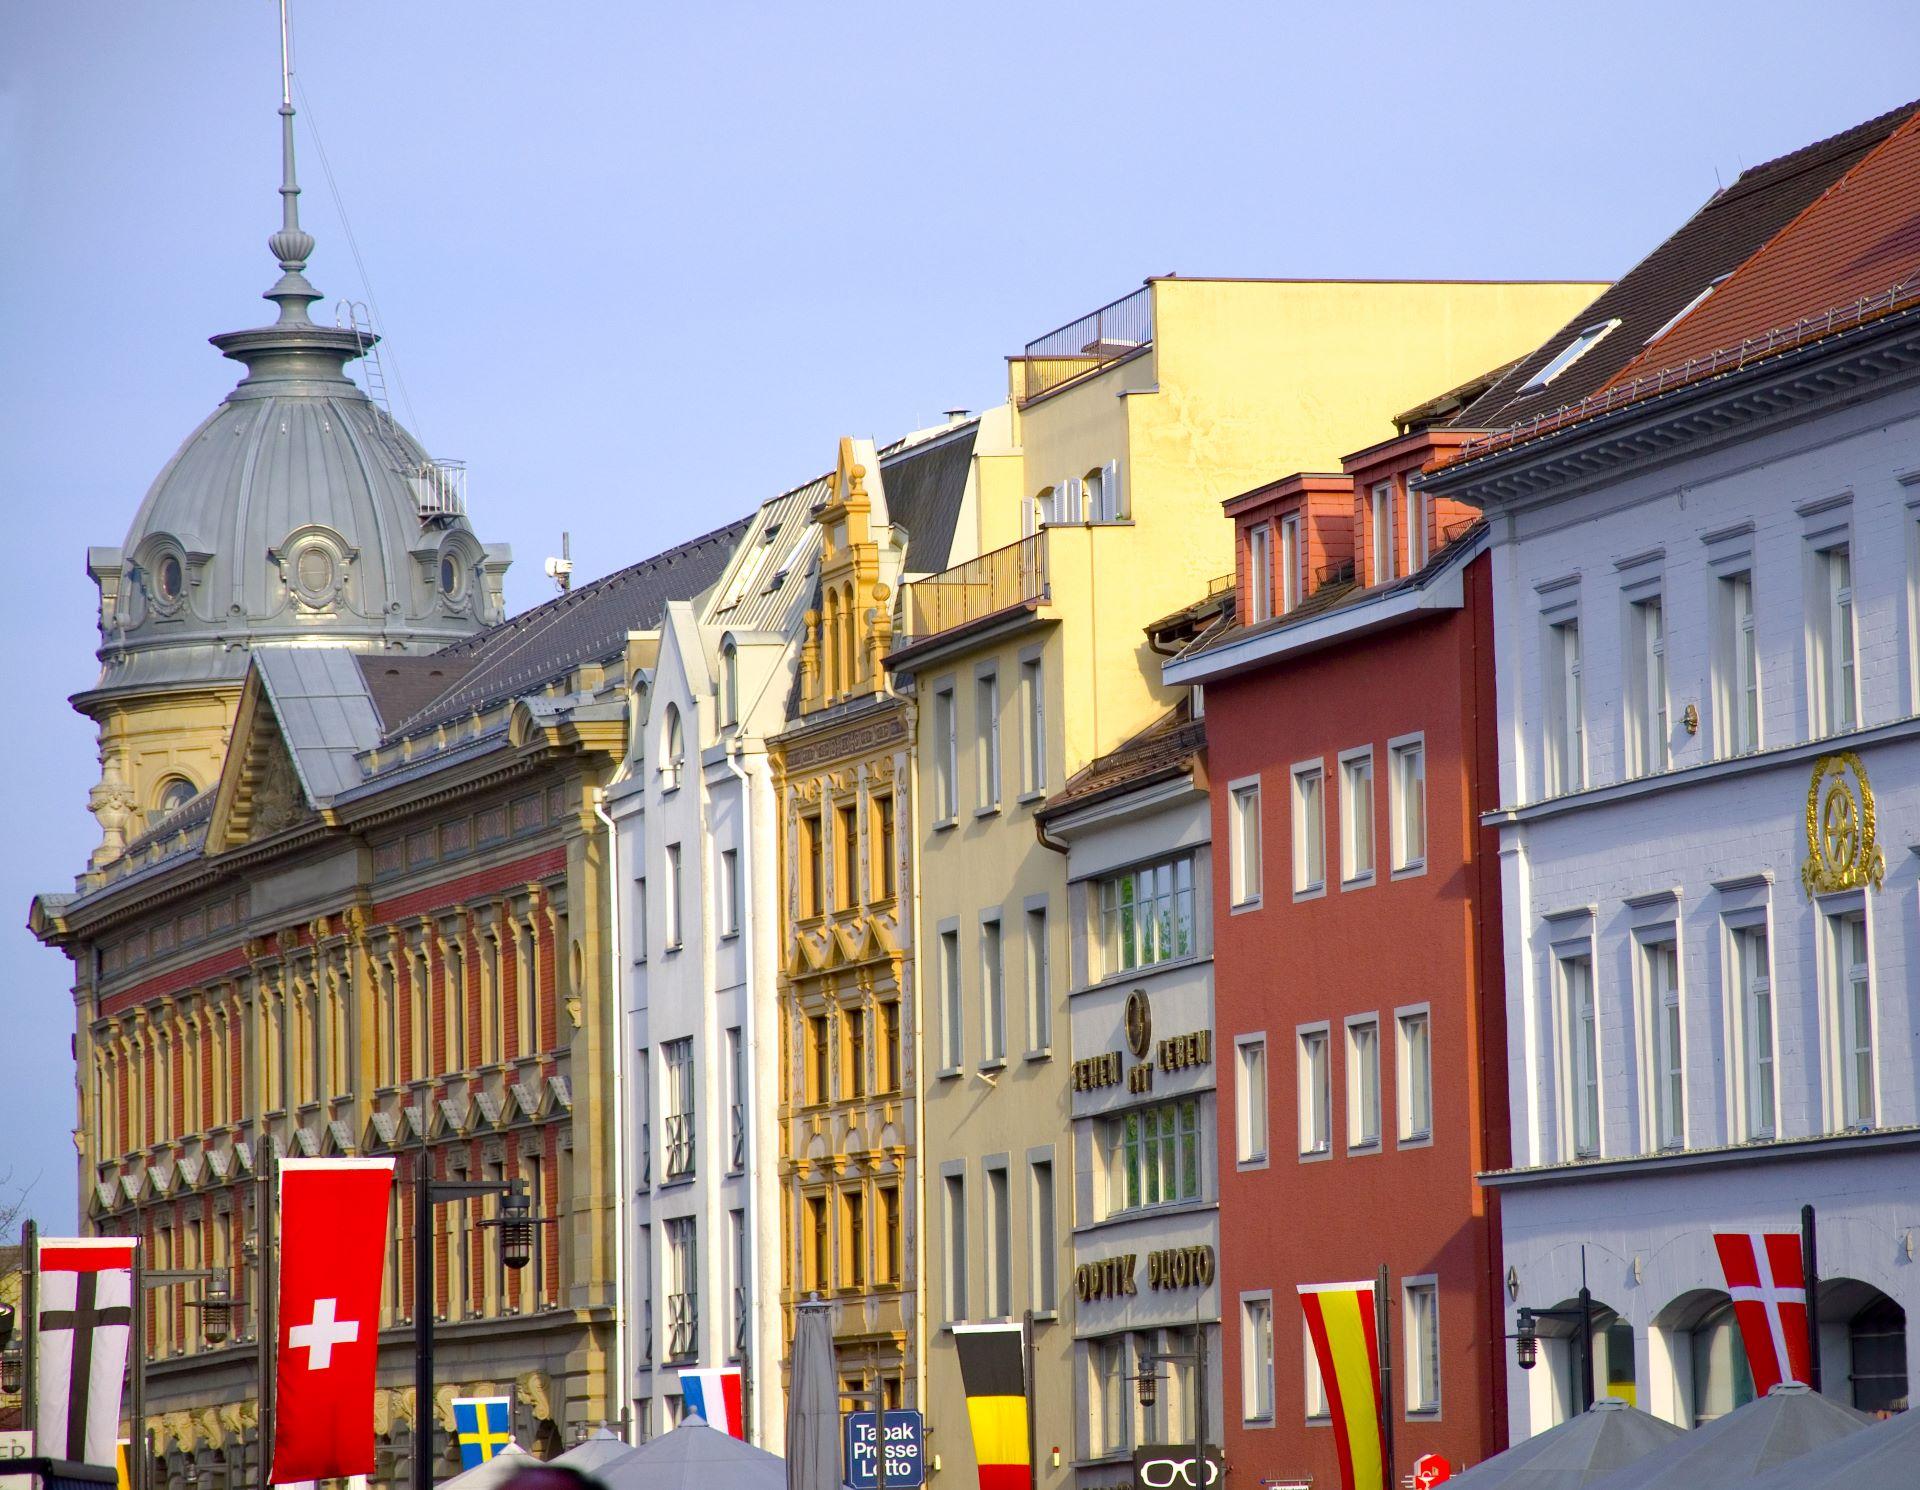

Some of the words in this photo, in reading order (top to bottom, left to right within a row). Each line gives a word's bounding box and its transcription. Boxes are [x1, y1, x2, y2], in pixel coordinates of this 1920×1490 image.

[1072, 1051, 1122, 1091] SEHEN
[1157, 1030, 1211, 1071] LEBEN
[1075, 1254, 1137, 1302] OPTIK
[1148, 1245, 1215, 1291] PHOTO
